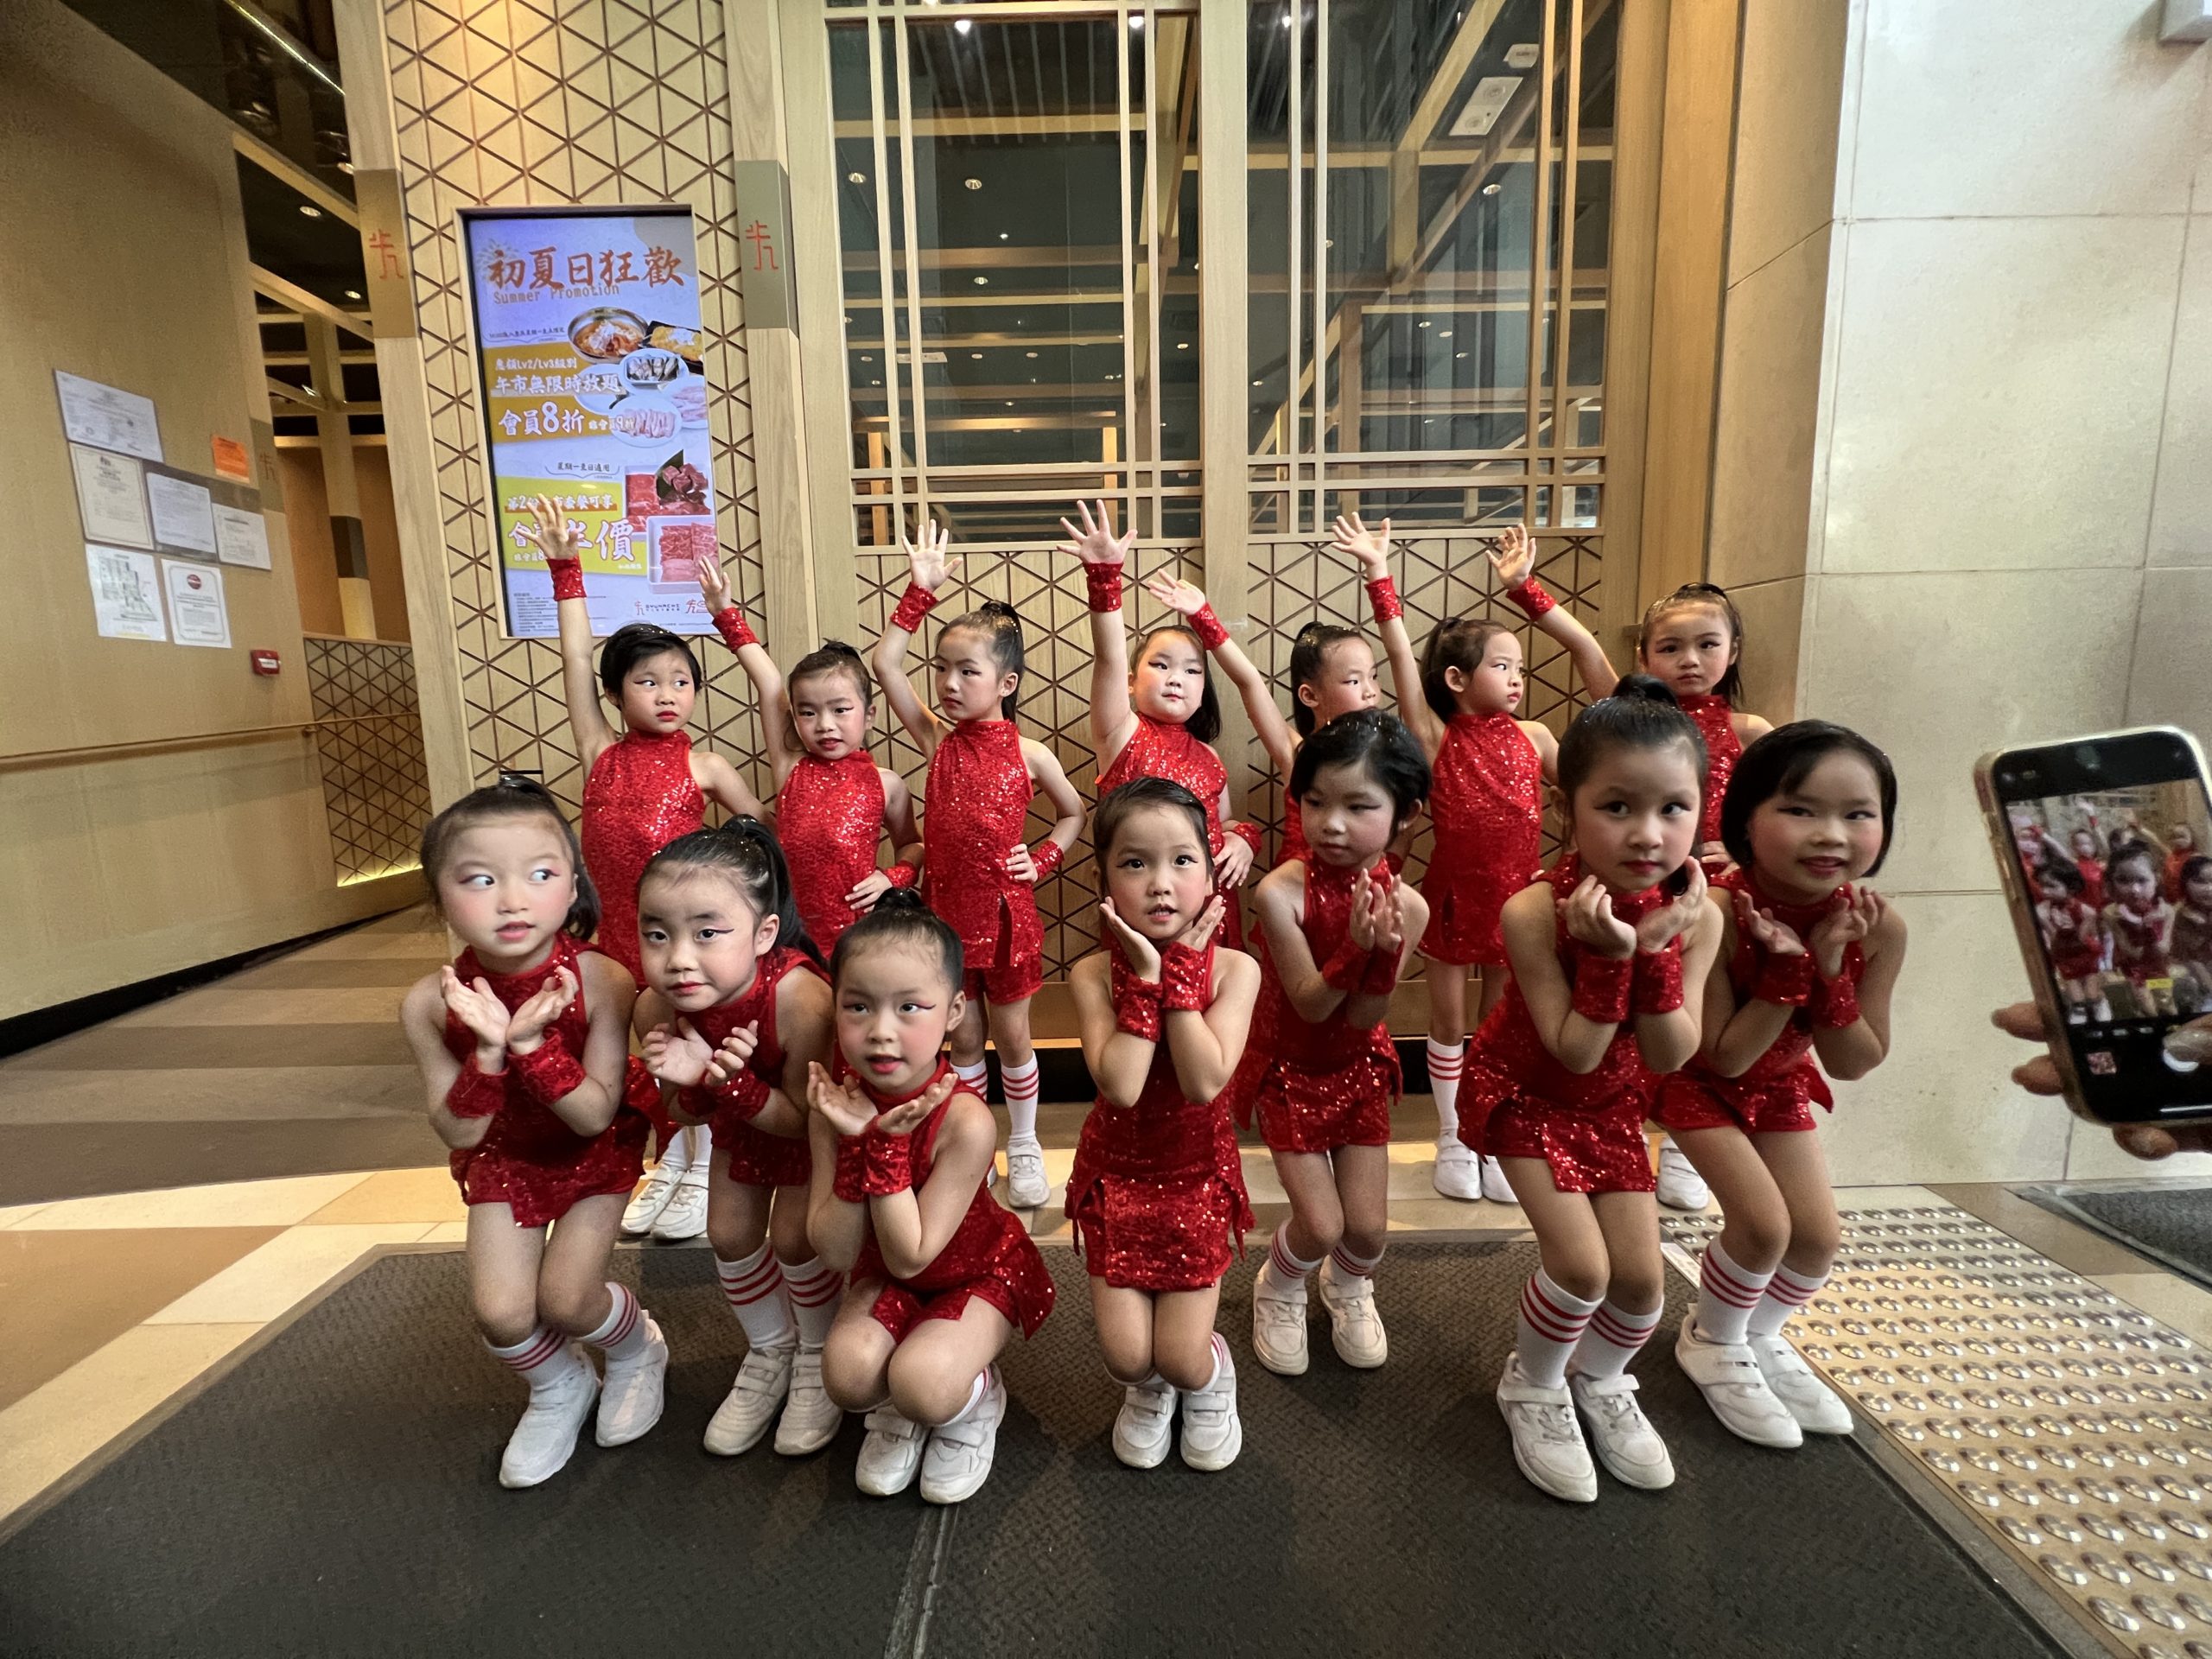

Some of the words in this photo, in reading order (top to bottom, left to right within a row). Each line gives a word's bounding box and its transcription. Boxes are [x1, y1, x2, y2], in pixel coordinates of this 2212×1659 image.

[487, 245, 685, 289] 初夏日狂歡
[493, 289, 541, 304] Summer
[550, 282, 620, 300] Promotion
[495, 372, 621, 395] 午市無限時放題
[498, 401, 585, 435] 會員8折
